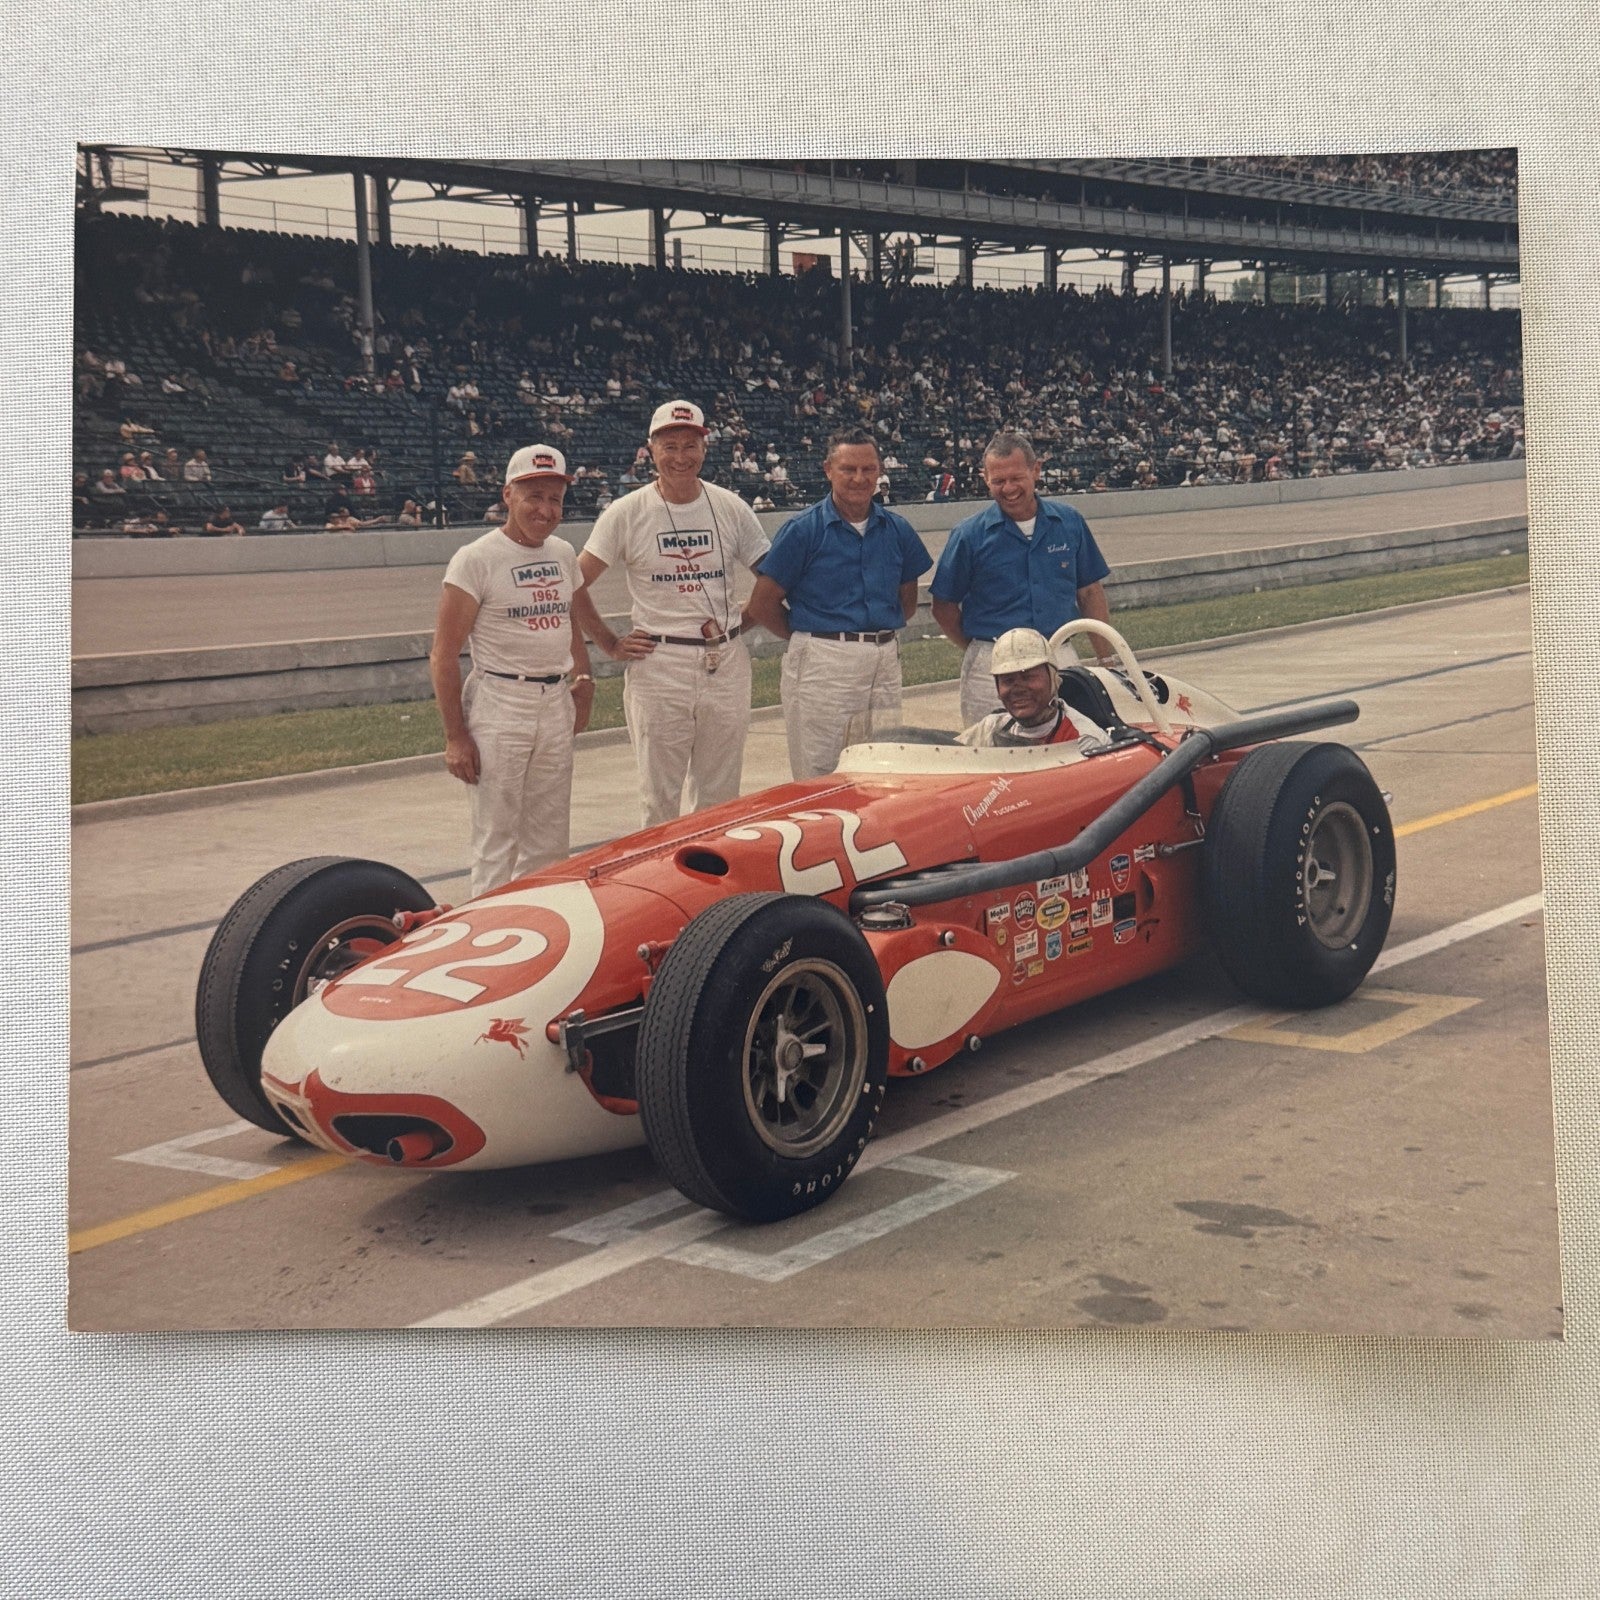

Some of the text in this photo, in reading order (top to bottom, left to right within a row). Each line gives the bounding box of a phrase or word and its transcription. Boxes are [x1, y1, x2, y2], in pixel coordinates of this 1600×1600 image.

[663, 535, 709, 548] Mobil
[518, 566, 559, 581] Mobil
[675, 564, 700, 573] 1963
[652, 570, 724, 581] INDIANAPOLIS
[532, 589, 560, 602] 1962
[507, 602, 570, 618] INDIANAPOL
[725, 808, 909, 897] 22
[990, 907, 1009, 918] Mobil
[335, 920, 548, 1004] 22
